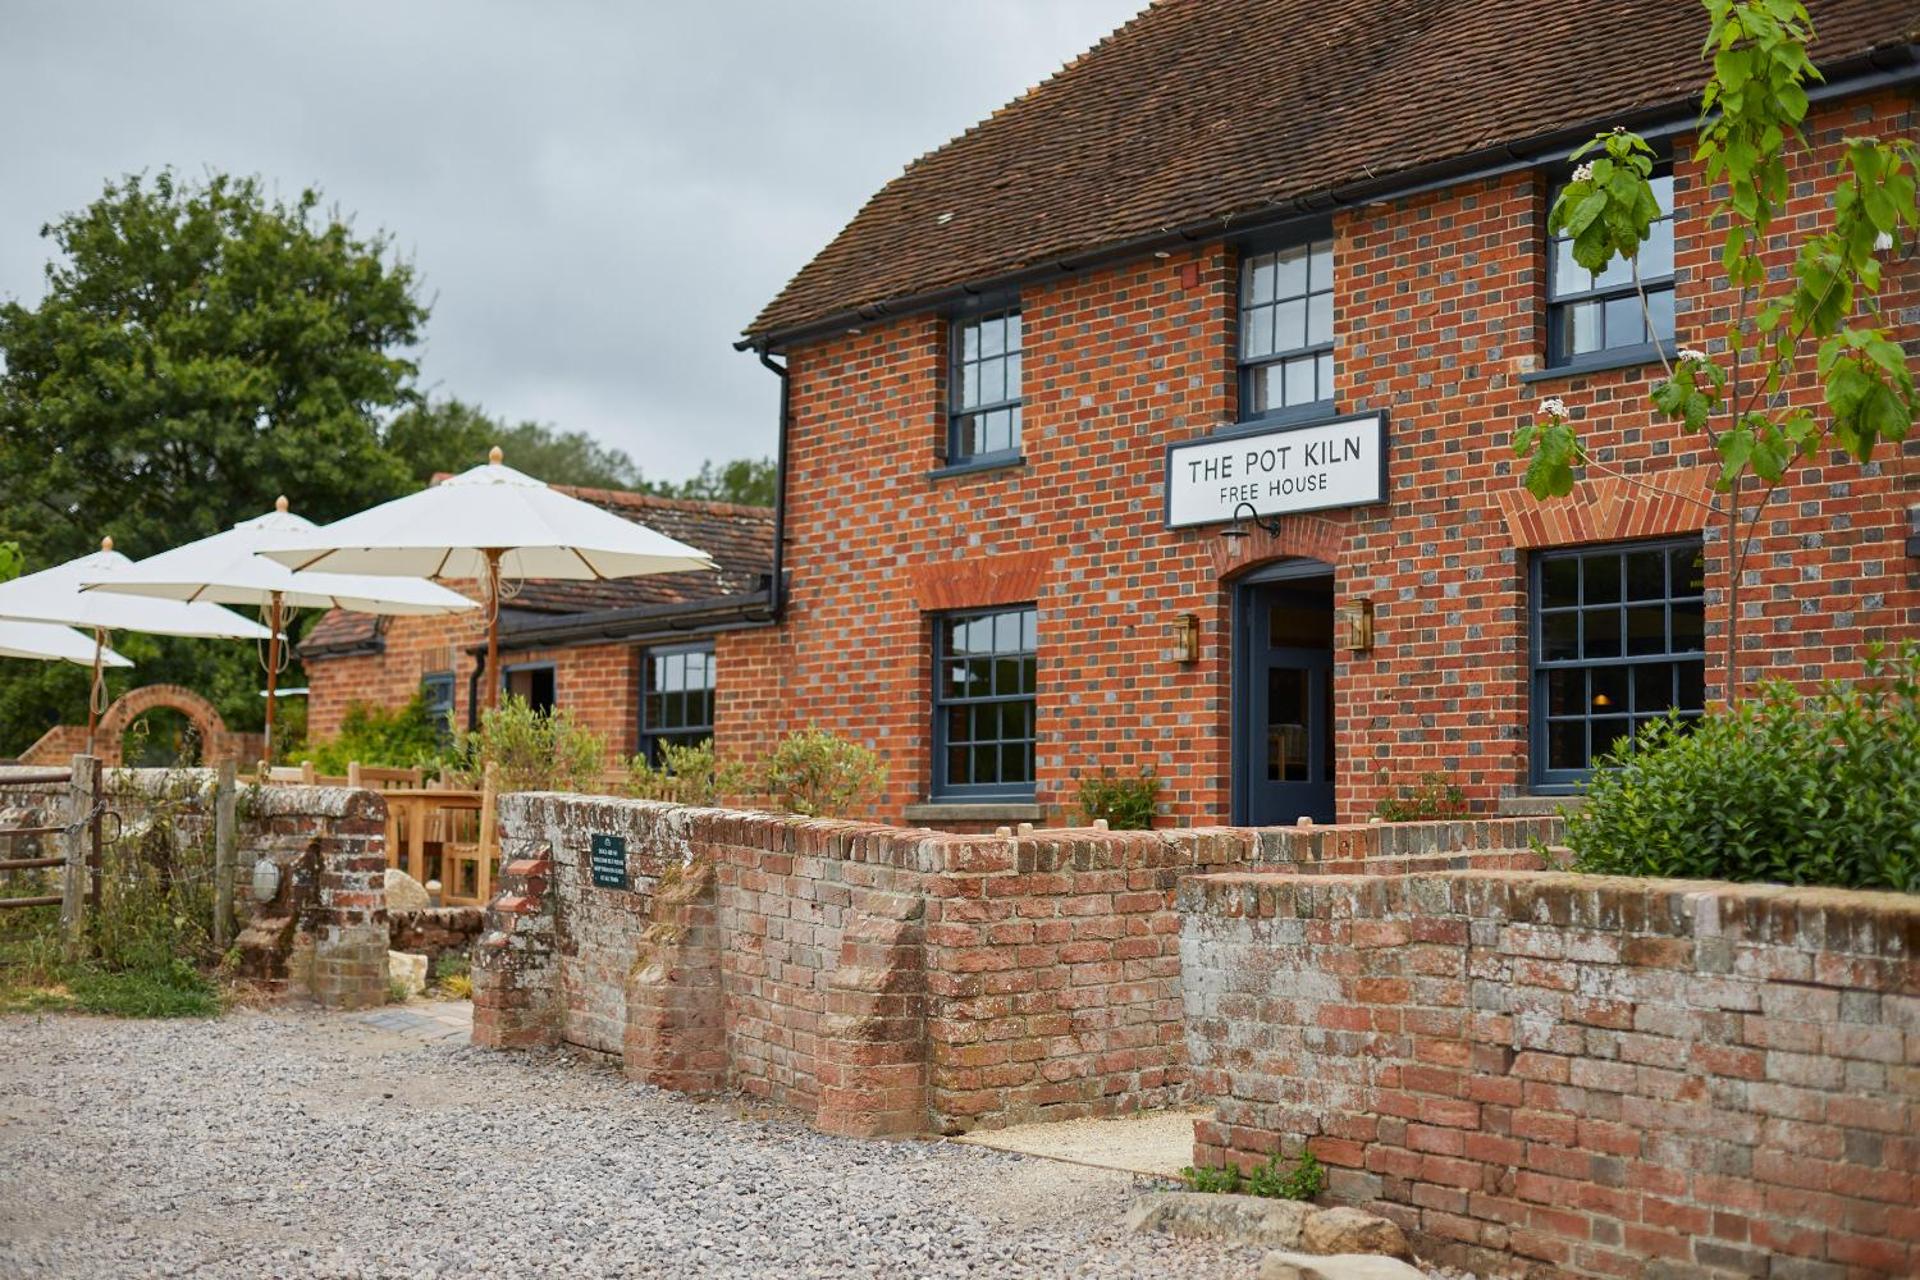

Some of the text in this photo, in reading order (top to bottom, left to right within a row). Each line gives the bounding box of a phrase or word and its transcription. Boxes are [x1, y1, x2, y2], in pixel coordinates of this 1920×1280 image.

[1188, 436, 1360, 483] THE POT KILN
[1220, 473, 1327, 504] FREE HOUSE
